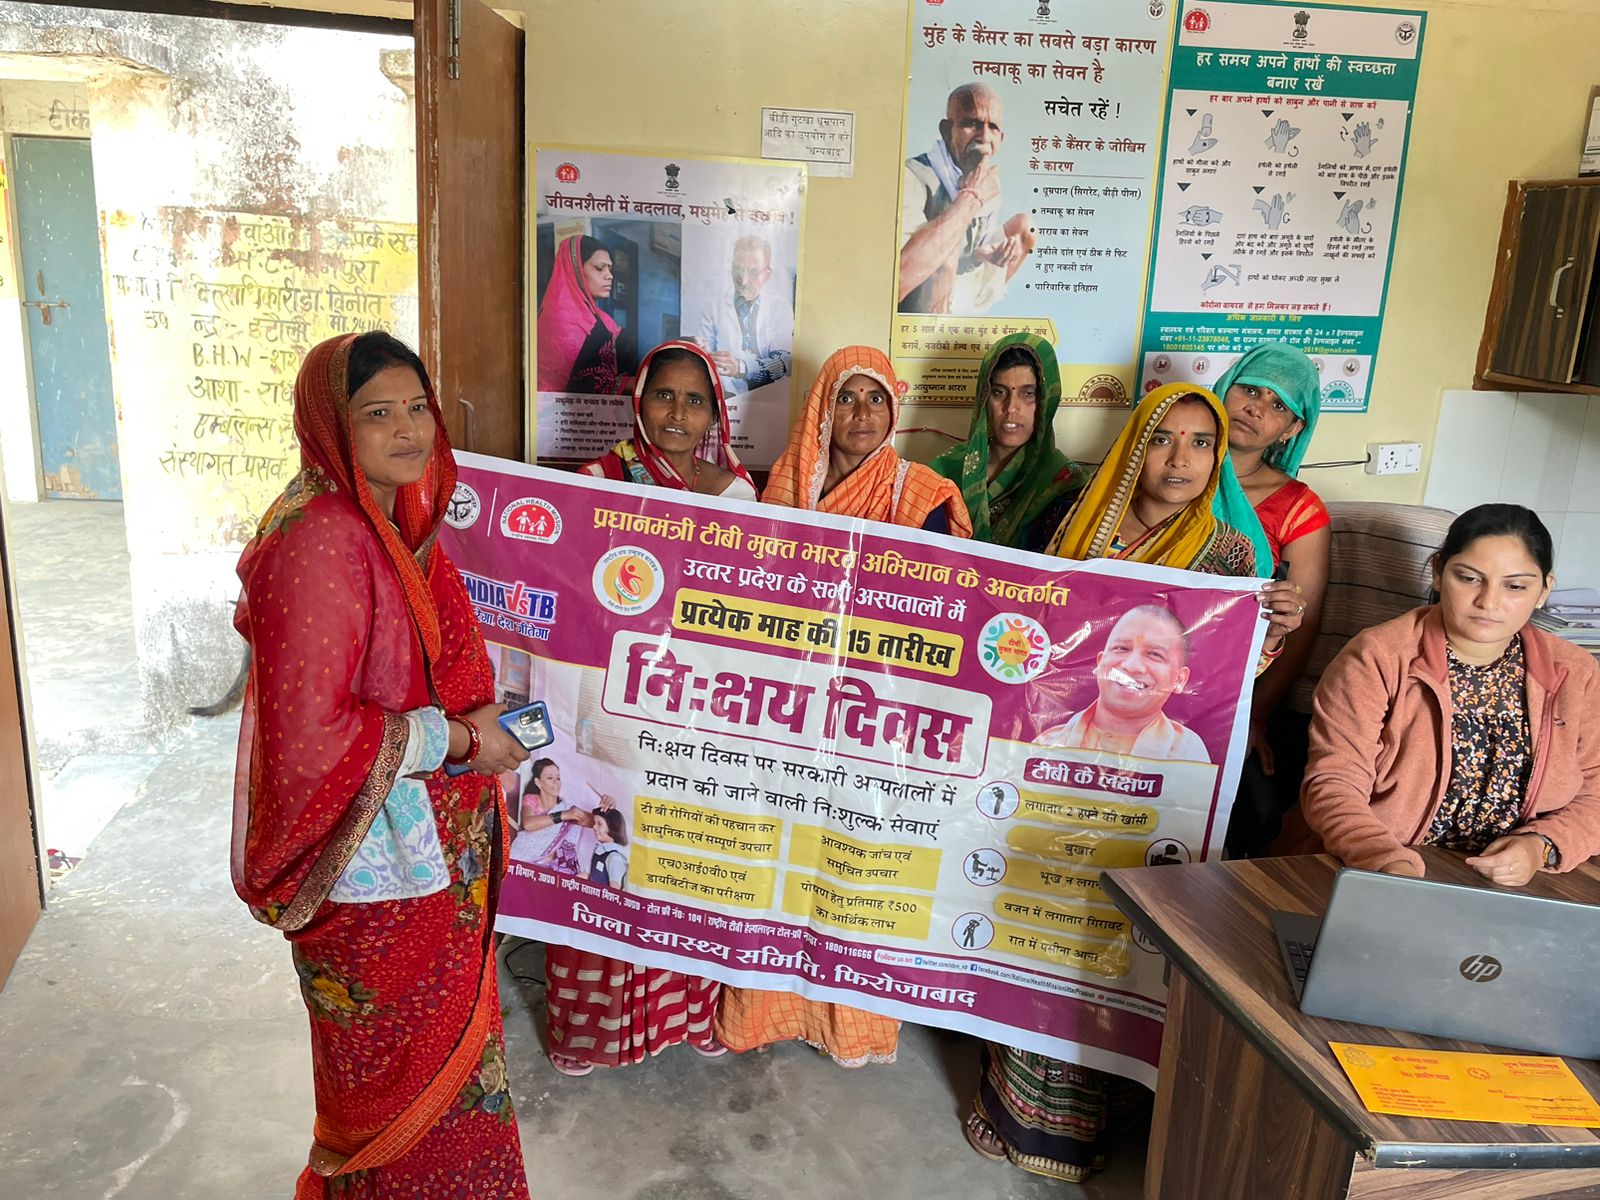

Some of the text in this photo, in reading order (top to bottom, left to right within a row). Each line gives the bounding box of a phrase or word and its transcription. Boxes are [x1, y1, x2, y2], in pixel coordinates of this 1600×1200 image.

[922, 21, 1156, 56] मुंह के कैंसर का सबसे बड़ा कारण
[972, 58, 1105, 84] तम्बाकू का सेवन है
[1196, 51, 1396, 76] हर समय अपने हाथों की स्वच्छता
[1266, 75, 1324, 91] बनाए रखें
[1044, 95, 1110, 120] सचेत रहें
[785, 130, 795, 138] का
[829, 133, 835, 141] न
[1031, 134, 1146, 153] मुंह के कैंसर के जोखिम
[1029, 157, 1074, 172] के कारण
[545, 191, 615, 212] जीवनशैली
[618, 195, 630, 213] में
[633, 201, 686, 220] बदलाव,
[1066, 208, 1075, 216] का
[1078, 206, 1095, 216] सेवन
[1039, 226, 1089, 237] शराब का सेवन
[1114, 249, 1128, 257] फिट
[1056, 261, 1077, 272] नकली
[1035, 281, 1098, 292] पारिवारिक इतिहास
[502, 500, 524, 525] NATIONAL
[526, 499, 552, 510] HEALTH
[593, 507, 1071, 607] प्रधानमंत्री टीबी मुक्त भारत अभियान के अन्तर्गत
[683, 558, 735, 585] उत्तर
[738, 566, 784, 592] प्रदेश
[786, 573, 808, 594] के
[811, 578, 853, 603] सभी
[855, 586, 944, 619] अस्पतालों
[947, 599, 967, 622] में
[681, 599, 955, 668] प्रत्येक माह की 15 तारीख
[825, 676, 973, 764] दिवस
[701, 741, 747, 769] दिवस
[754, 755, 777, 774] पर
[782, 761, 848, 788] सरकारी
[940, 784, 957, 806] में
[1031, 761, 1156, 793] टीबी के लक्षण
[645, 768, 687, 794] प्रदान
[694, 775, 717, 800] की
[724, 782, 761, 804] जाने
[764, 790, 809, 814] वाली
[889, 814, 942, 841] सेवाएं
[1025, 799, 1061, 816] लगातार
[1066, 806, 1073, 817] 2
[1102, 809, 1117, 824] की
[1120, 811, 1147, 826] खांसी
[640, 803, 776, 834] टी बी रोगियों की पहचान कर
[640, 822, 772, 853] आधुनिक एवं सम्पूर्ण उपचार
[821, 835, 913, 864] आवश्यक जांच एवं
[1064, 843, 1096, 857] बुखार
[729, 870, 747, 884] एवं
[826, 857, 899, 880] समुचित उपचार
[1040, 871, 1073, 886] भूख न
[646, 873, 755, 902] डायबिटीज का परीक्षण
[801, 880, 917, 914] पोषण हेतु प्रतिमाह ₹500
[815, 905, 896, 931] का आर्थिक लाभ
[1004, 901, 1124, 932] वजन में लगातार गिरावट
[571, 902, 977, 1008] जिला स्वास्थ्य समिति, फिरोजाबाद
[1009, 934, 1025, 948] रात
[1029, 937, 1039, 951] में
[1461, 955, 1500, 983] hp
